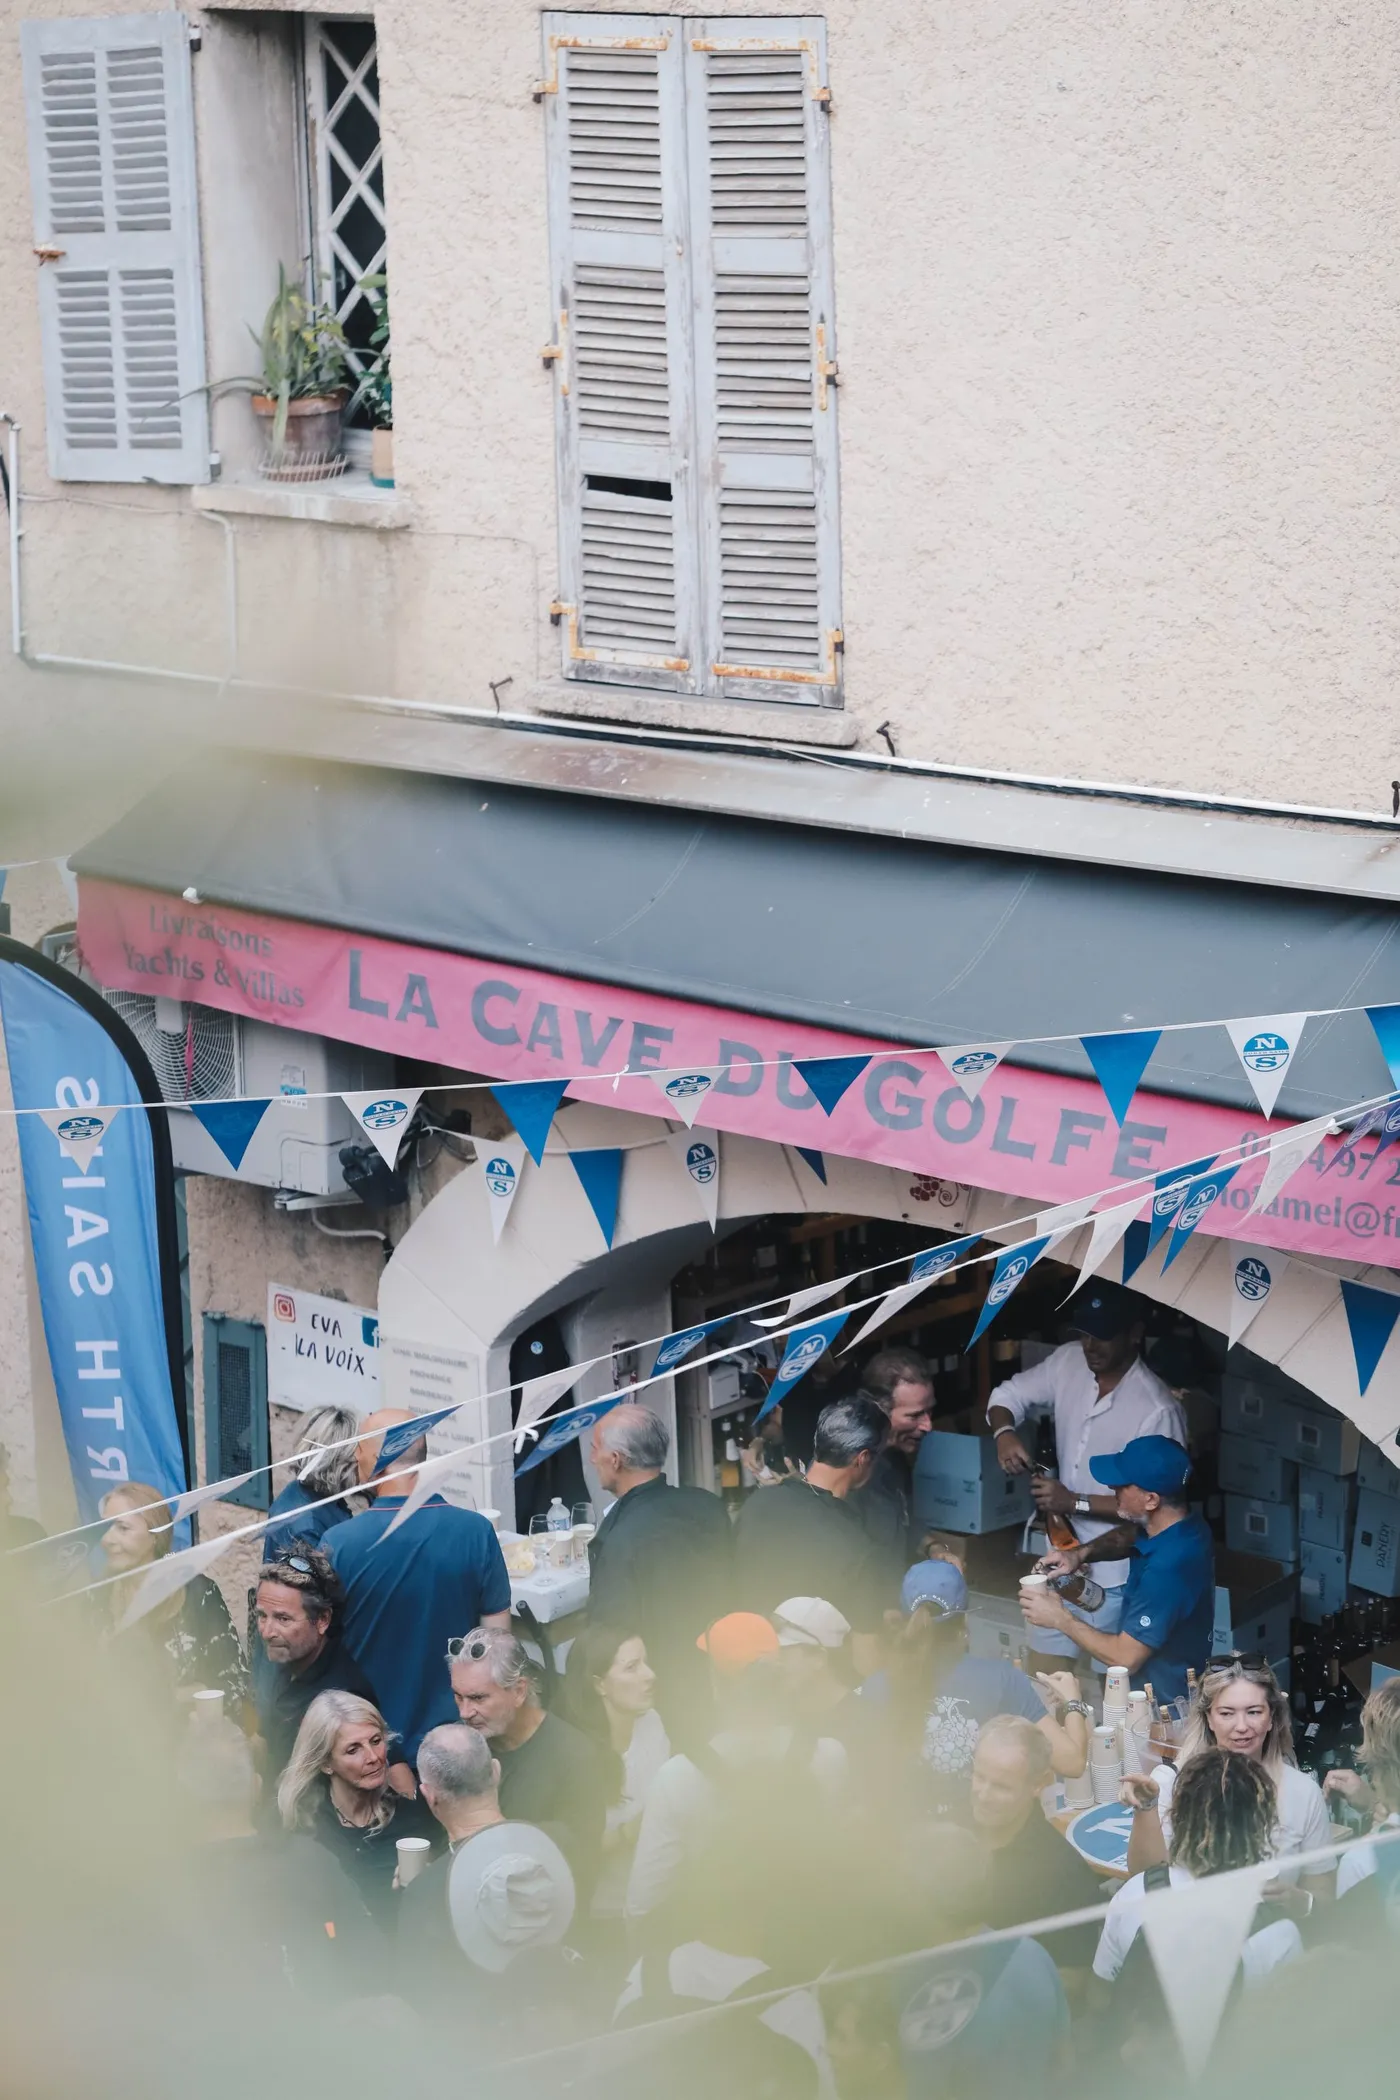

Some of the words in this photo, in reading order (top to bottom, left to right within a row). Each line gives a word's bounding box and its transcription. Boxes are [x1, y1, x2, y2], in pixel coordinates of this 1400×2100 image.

[150, 905, 273, 959] Livraisons
[121, 940, 205, 981] Yachts
[213, 957, 232, 988] &
[234, 963, 305, 1008] Villas
[1254, 1037, 1278, 1049] N
[348, 949, 440, 1030] LA
[470, 979, 675, 1077] CAVE
[863, 1060, 1168, 1184] GOLFE
[1255, 1056, 1277, 1068] S
[372, 1101, 396, 1114] N
[375, 1115, 397, 1127] S
[690, 1146, 706, 1161] N
[492, 1160, 508, 1174] N
[697, 1166, 711, 1180] S
[493, 1181, 507, 1192] S
[1003, 1261, 1024, 1279] N
[1245, 1260, 1266, 1278] N
[1241, 1281, 1259, 1296] S
[325, 1346, 365, 1376] VOIX
